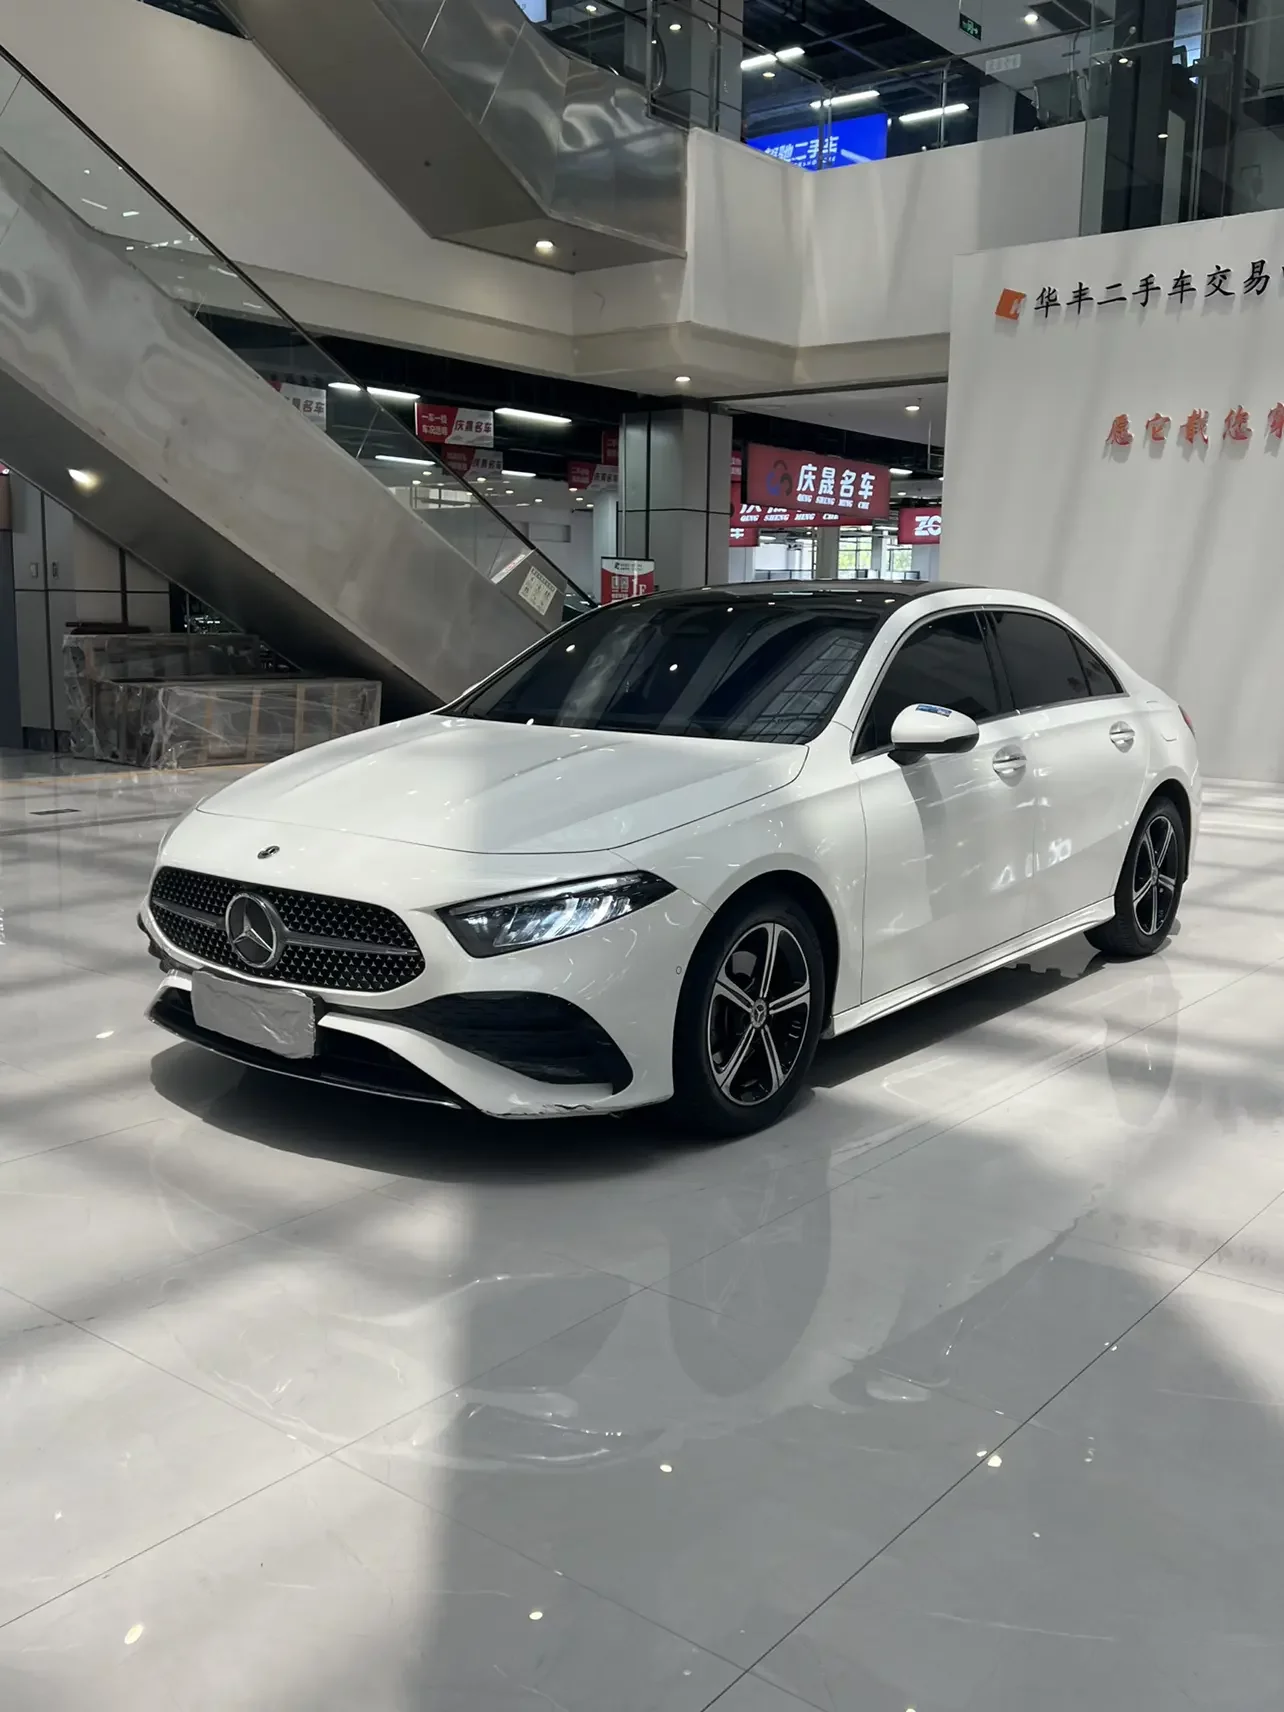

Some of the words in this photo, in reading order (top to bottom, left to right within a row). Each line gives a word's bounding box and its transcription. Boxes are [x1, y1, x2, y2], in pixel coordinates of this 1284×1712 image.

[1034, 259, 1284, 318] 华丰二手车交易
[796, 463, 876, 500] 庆晟名车
